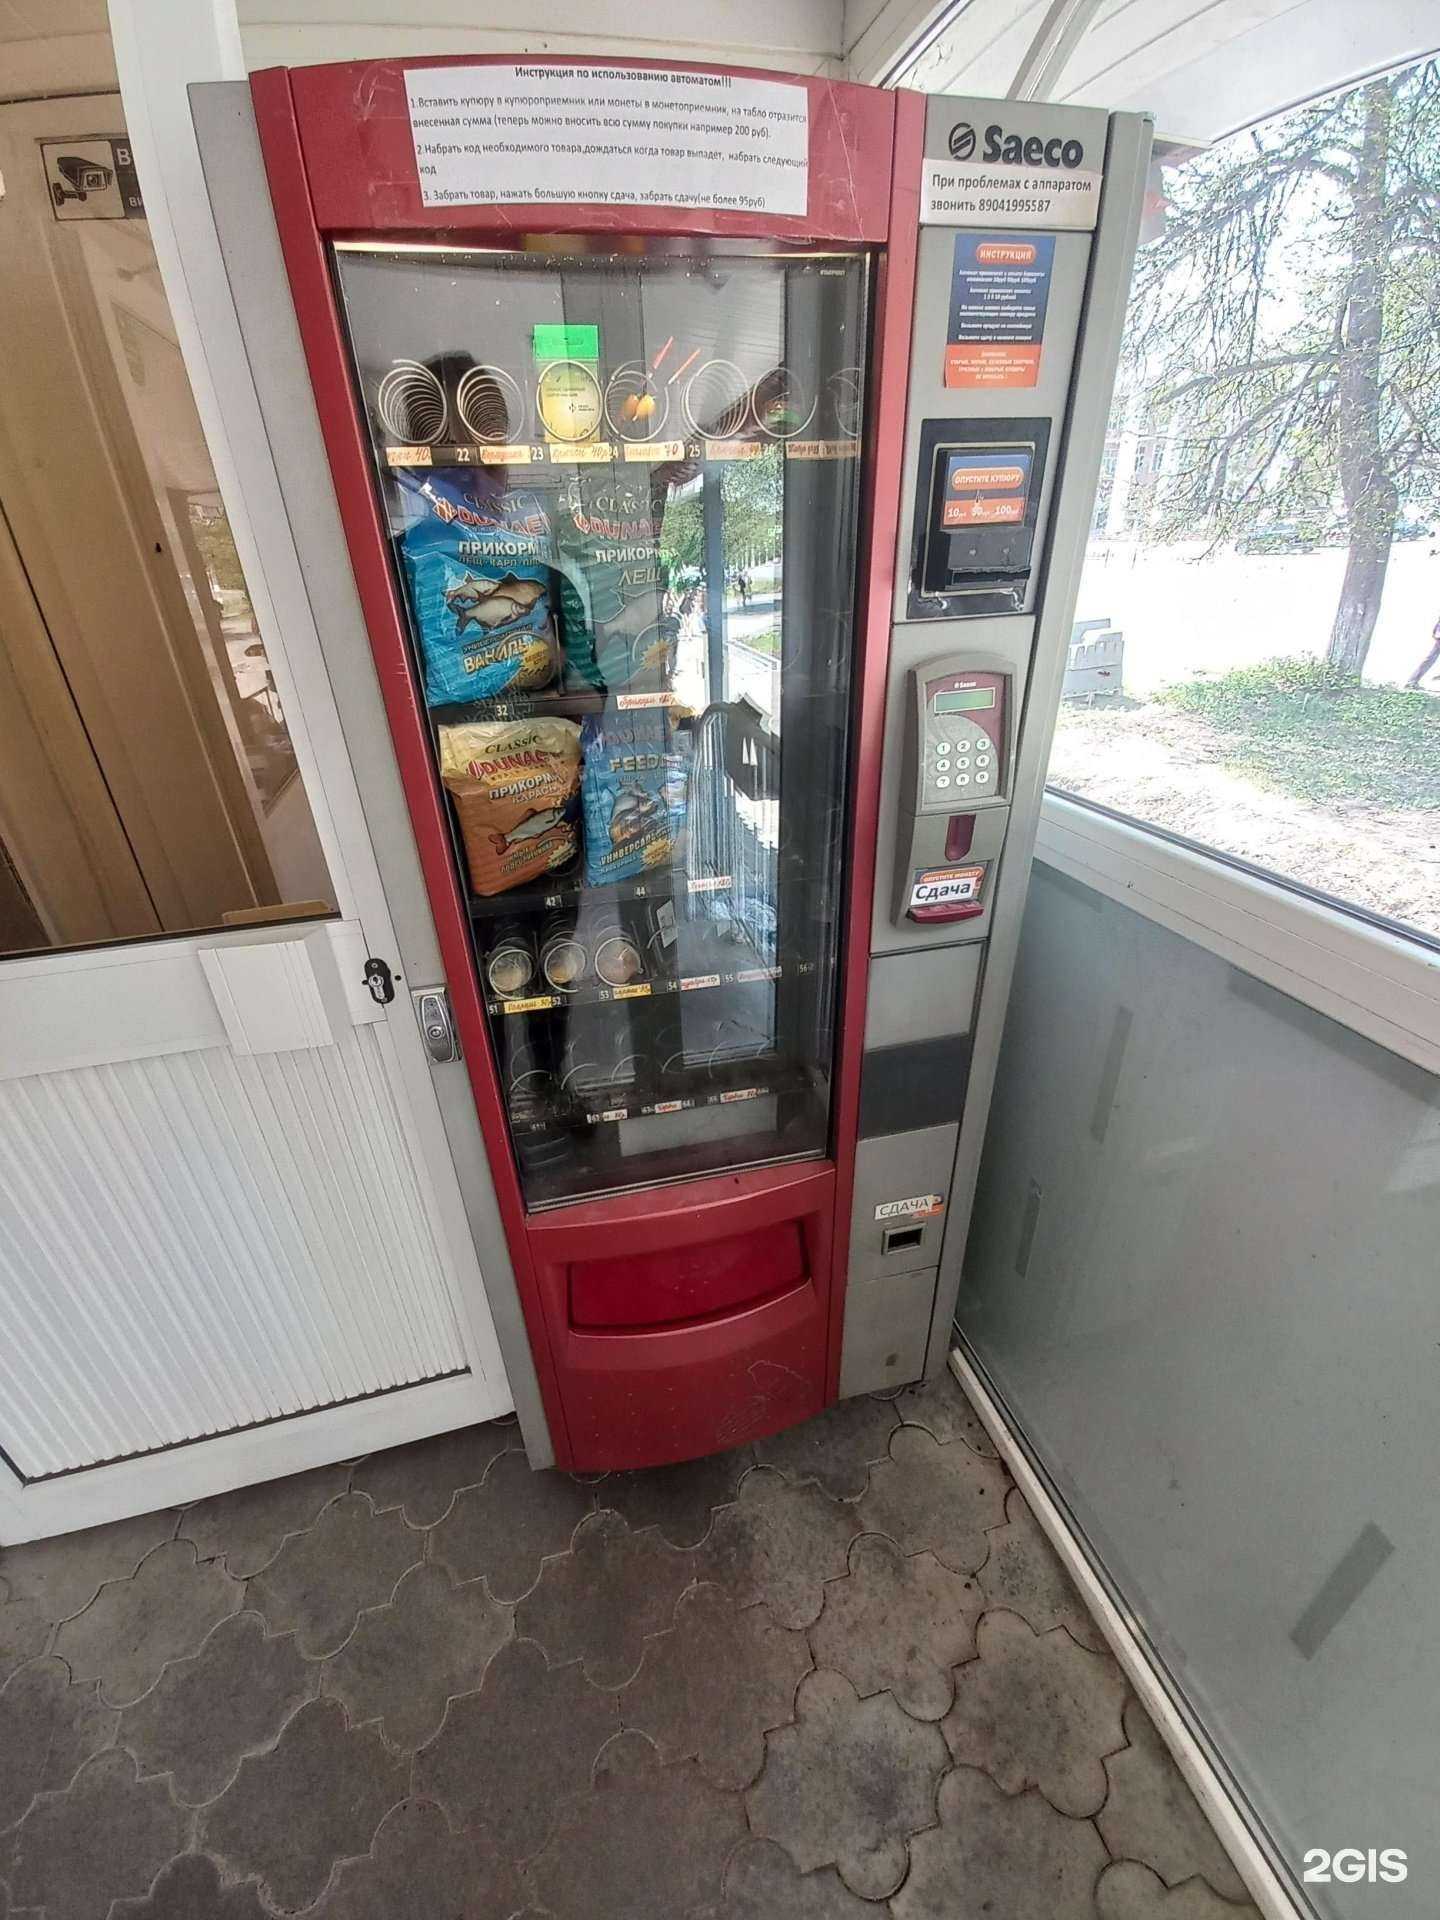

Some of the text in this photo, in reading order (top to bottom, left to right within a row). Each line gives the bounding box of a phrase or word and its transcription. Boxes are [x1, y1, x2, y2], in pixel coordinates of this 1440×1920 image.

[514, 67, 732, 88] Инструкция по использованию автоматом!!!
[460, 97, 495, 108] купюру
[497, 97, 502, 105] в
[504, 97, 586, 108] купюроприемник
[588, 98, 604, 106] или
[607, 98, 643, 108] монеты
[644, 100, 650, 108] в
[652, 101, 729, 117] монетоприемник,
[731, 107, 742, 116] на
[743, 107, 767, 118] табло
[413, 117, 460, 128] внесенная
[462, 117, 491, 128] сумма
[494, 114, 529, 128] (теперь
[531, 117, 563, 126] можно
[565, 117, 601, 126] вносить
[603, 118, 621, 127] всю
[622, 119, 651, 130] сумму
[653, 121, 688, 133] покупки
[690, 124, 733, 137] например
[735, 125, 750, 136] 200
[463, 144, 482, 154] код
[482, 142, 549, 154] необходимого
[634, 147, 659, 158] когда
[661, 148, 685, 160] товар
[686, 150, 725, 162] выпадет,
[728, 152, 761, 165] набрать
[982, 125, 1084, 168] Saeco
[419, 165, 437, 175] код
[932, 174, 1092, 192] При проблемах с аппаратом
[433, 189, 468, 201] Забрать
[470, 190, 498, 201] товар,
[500, 190, 532, 200] нажать
[534, 188, 576, 200] большую
[577, 191, 608, 201] кнопку
[610, 192, 638, 202] сдача,
[640, 191, 673, 203] забрать
[712, 194, 738, 205] более
[930, 199, 1051, 213] звонить 89041995587
[456, 448, 470, 462] 22
[531, 446, 544, 461] 23
[689, 444, 700, 457] 25
[459, 541, 550, 557] ПРИКОРМ
[595, 547, 677, 562] ПРИКОРМ
[463, 638, 528, 674] ВАНИЛЬ
[496, 704, 508, 716] 32
[485, 735, 541, 754] CLASSIC
[636, 886, 646, 896] 44
[916, 883, 971, 901] Сдача
[668, 981, 677, 991] 54
[725, 974, 734, 983] 55
[552, 996, 561, 1006] 52
[600, 990, 609, 999] 53
[489, 1004, 498, 1014] 51
[879, 1198, 929, 1216] СДАЧА
